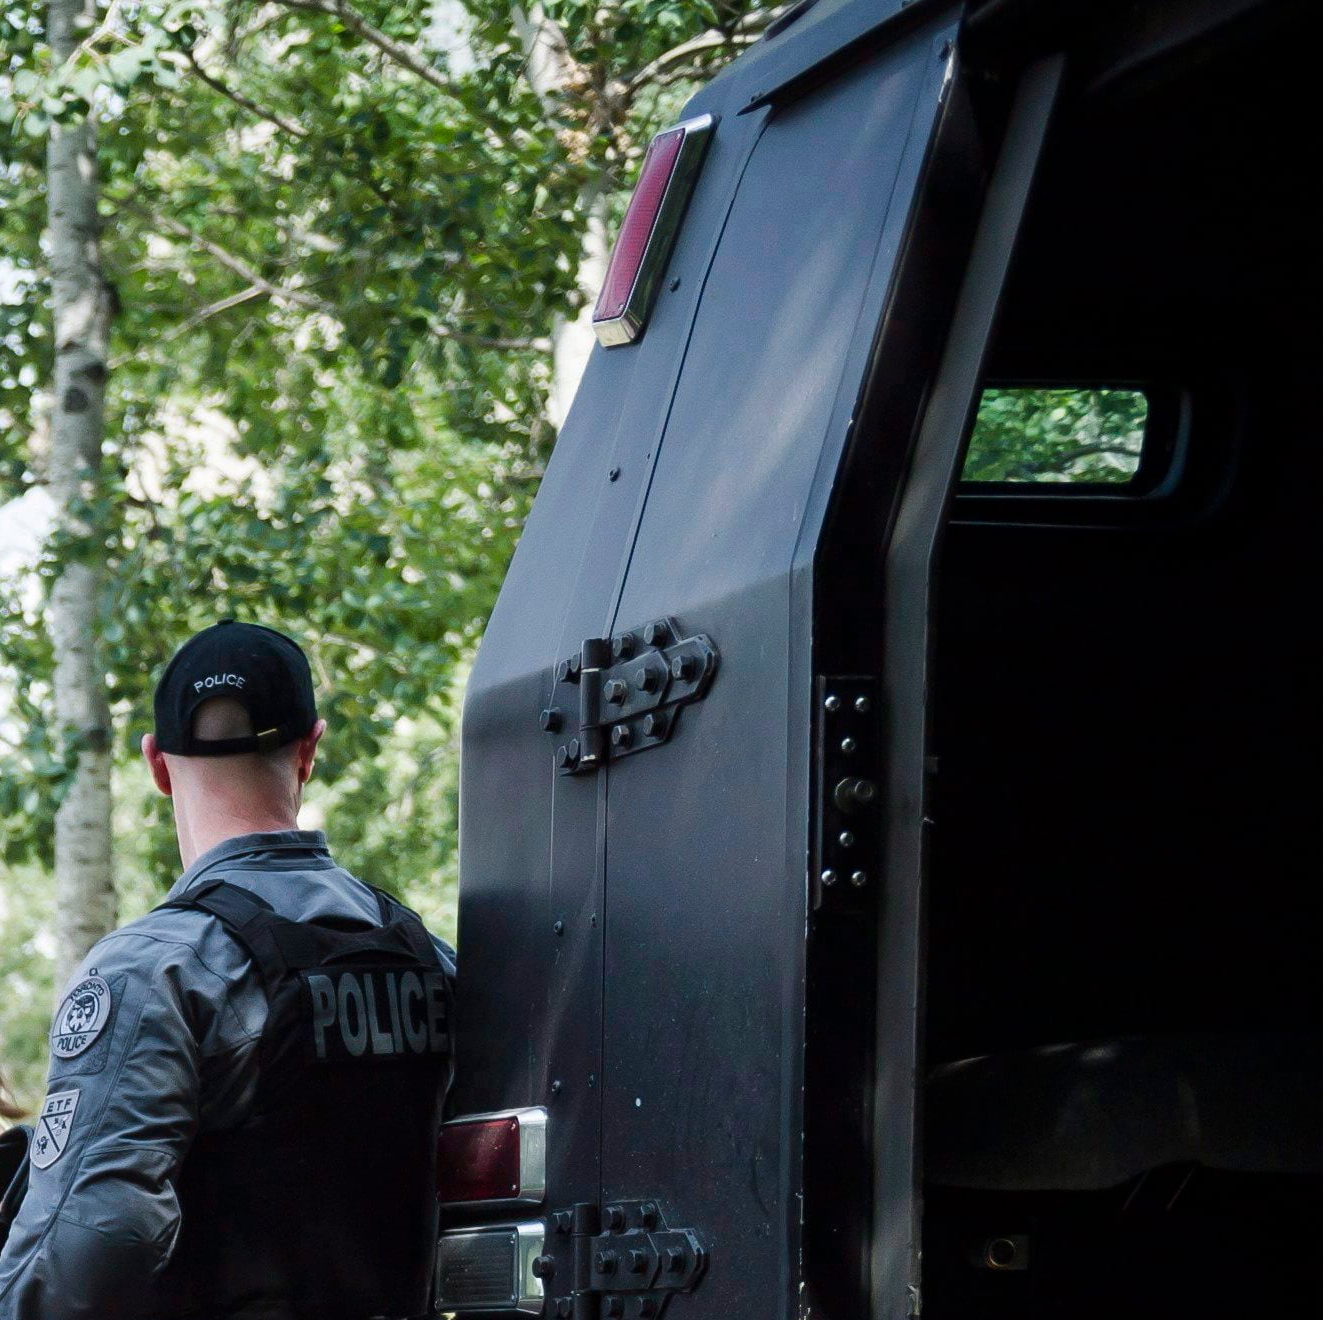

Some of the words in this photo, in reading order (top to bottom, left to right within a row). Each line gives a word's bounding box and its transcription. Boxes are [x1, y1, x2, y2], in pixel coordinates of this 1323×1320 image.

[194, 673, 246, 693] POLICE
[307, 971, 450, 1058] POLICE
[57, 1034, 88, 1052] POLICE
[47, 1098, 72, 1112] ETF
